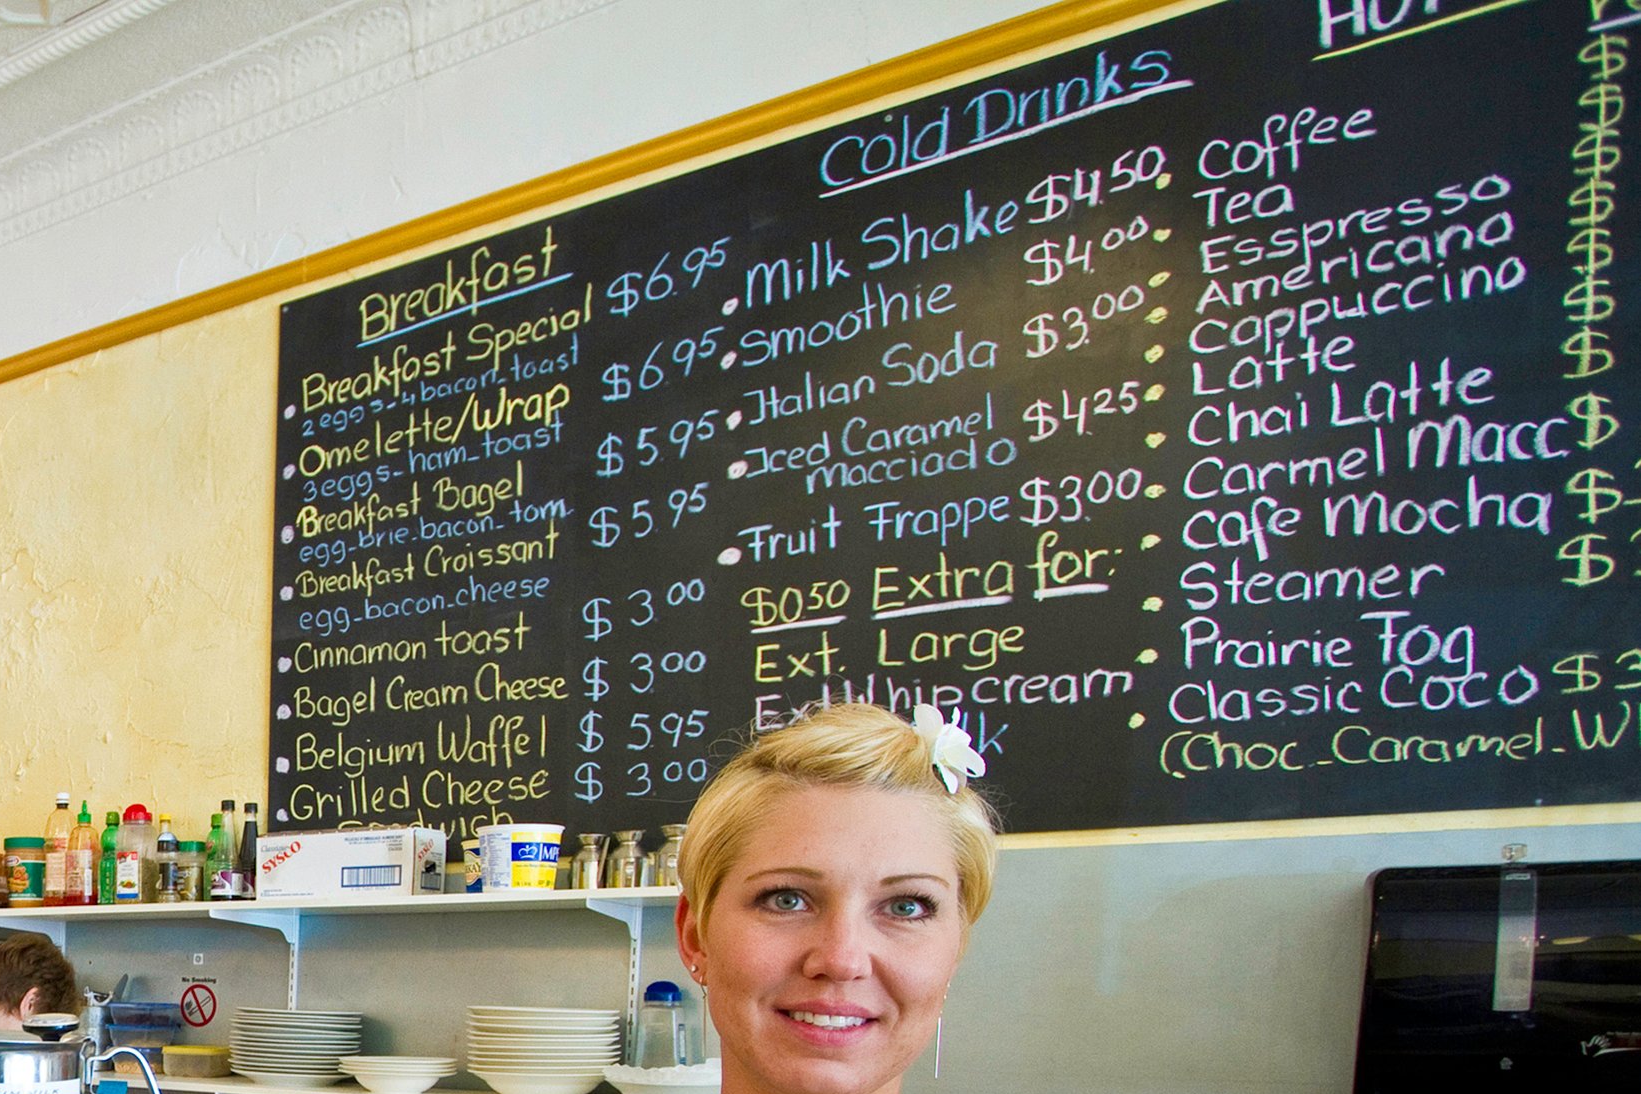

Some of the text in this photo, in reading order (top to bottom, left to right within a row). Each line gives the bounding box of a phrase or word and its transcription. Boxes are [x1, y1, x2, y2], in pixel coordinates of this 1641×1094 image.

[820, 50, 1172, 187] Cold Drinks
[1199, 107, 1377, 180] Coffee
[1193, 184, 1293, 227] Tea
[1200, 174, 1510, 274] Esspresso
[359, 225, 558, 341] Breakfast
[746, 188, 1019, 309] Milk Shake
[1196, 211, 1514, 313] Americano
[740, 282, 959, 368] Smoothie
[1188, 256, 1528, 353] Cappuccino
[302, 282, 593, 413] Breakfast Special
[743, 330, 999, 426] Italian Soda
[1193, 335, 1356, 396] Latte
[745, 393, 993, 479] Iced Caramel
[1188, 358, 1494, 446] Chai Latte
[296, 460, 523, 538] Breakfast Bagel
[1183, 427, 1385, 499] Carmel
[296, 518, 560, 598] Breakfast Croissant
[737, 495, 1011, 562] Fruit Frappe
[872, 551, 1015, 611] Extra
[1180, 557, 1445, 610] Steamer
[293, 611, 532, 675] Cinnamon toast
[878, 626, 1025, 670] Large
[1181, 616, 1354, 670] Prairie
[293, 661, 570, 727] Bagel Cream Cheese
[1169, 664, 1539, 724] Classic Coco
[295, 731, 426, 778] Belgium
[289, 770, 551, 822] Grilled Cheese
[262, 840, 302, 875] SYSCO
